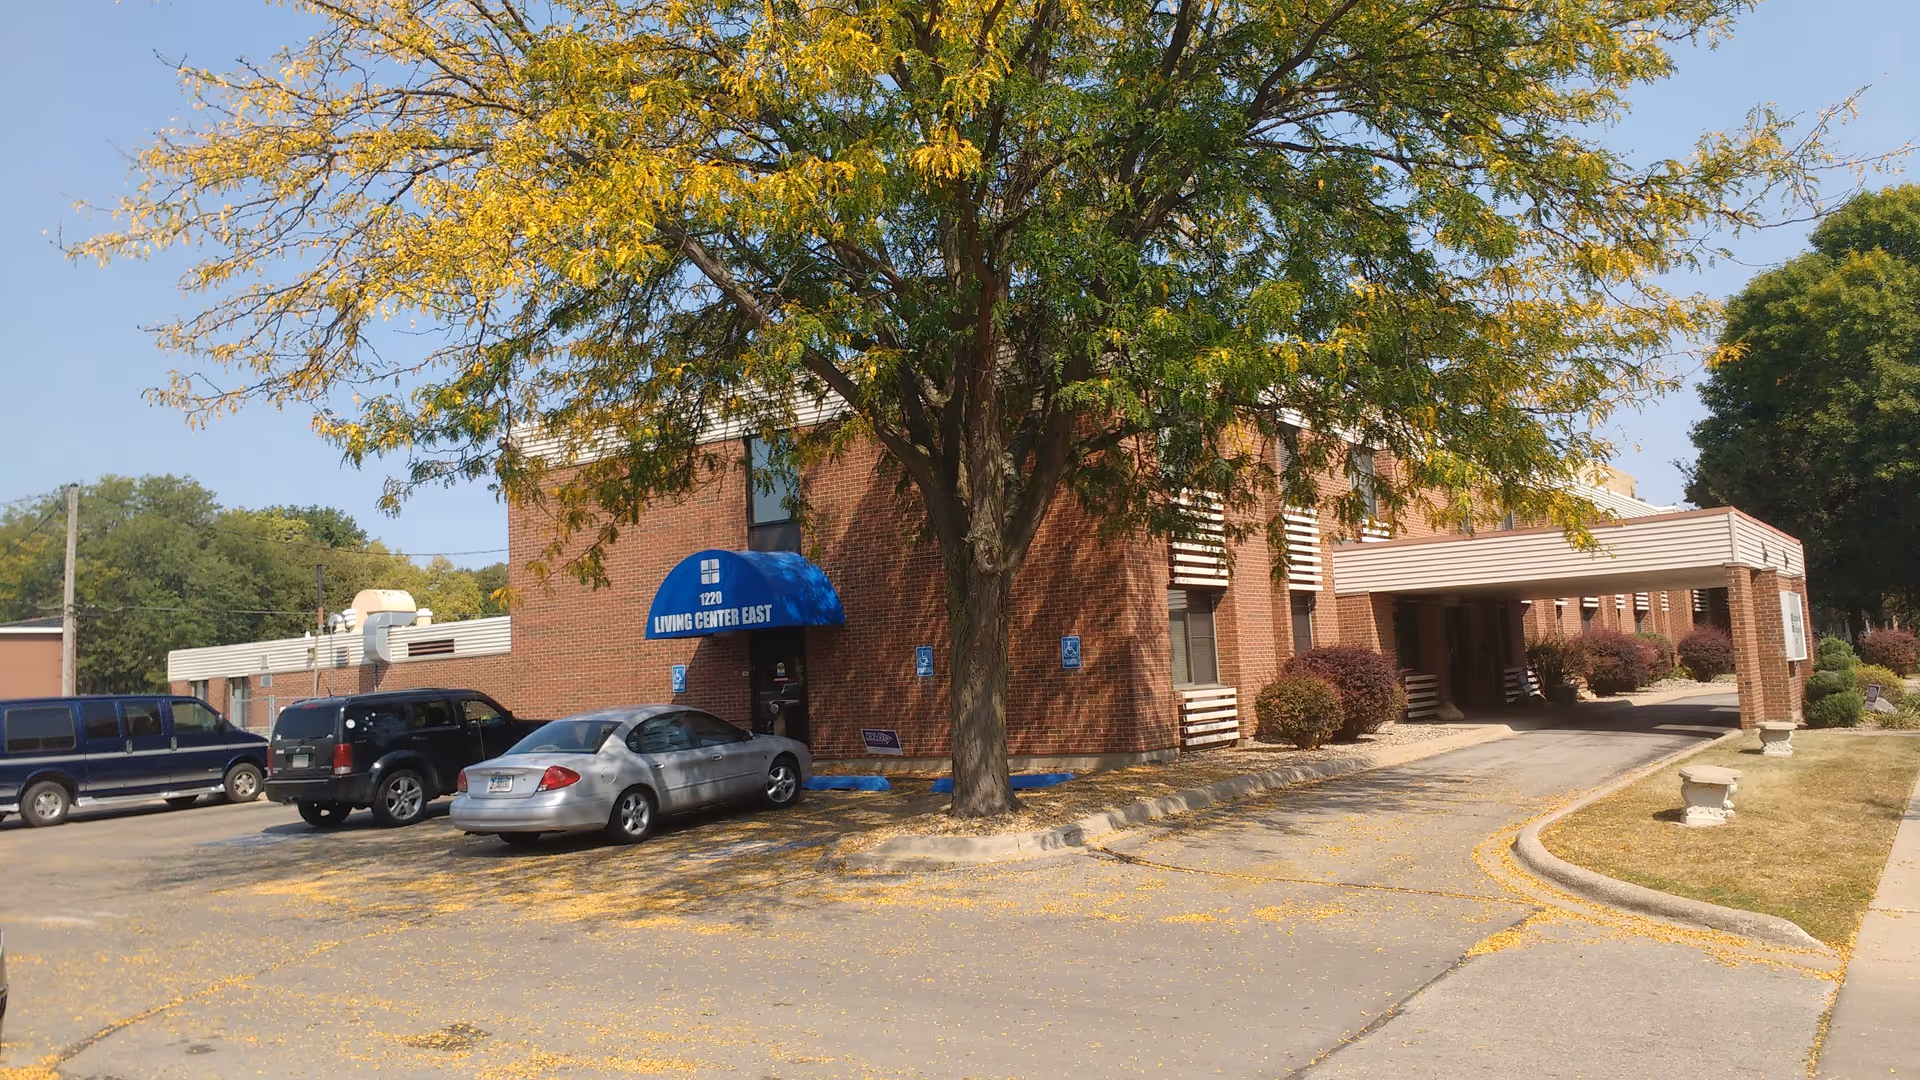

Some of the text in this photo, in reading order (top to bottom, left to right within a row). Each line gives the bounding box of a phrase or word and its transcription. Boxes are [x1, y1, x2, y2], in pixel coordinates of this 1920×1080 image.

[699, 591, 722, 606] 1220
[654, 604, 773, 634] LIVING CENTER EAST
